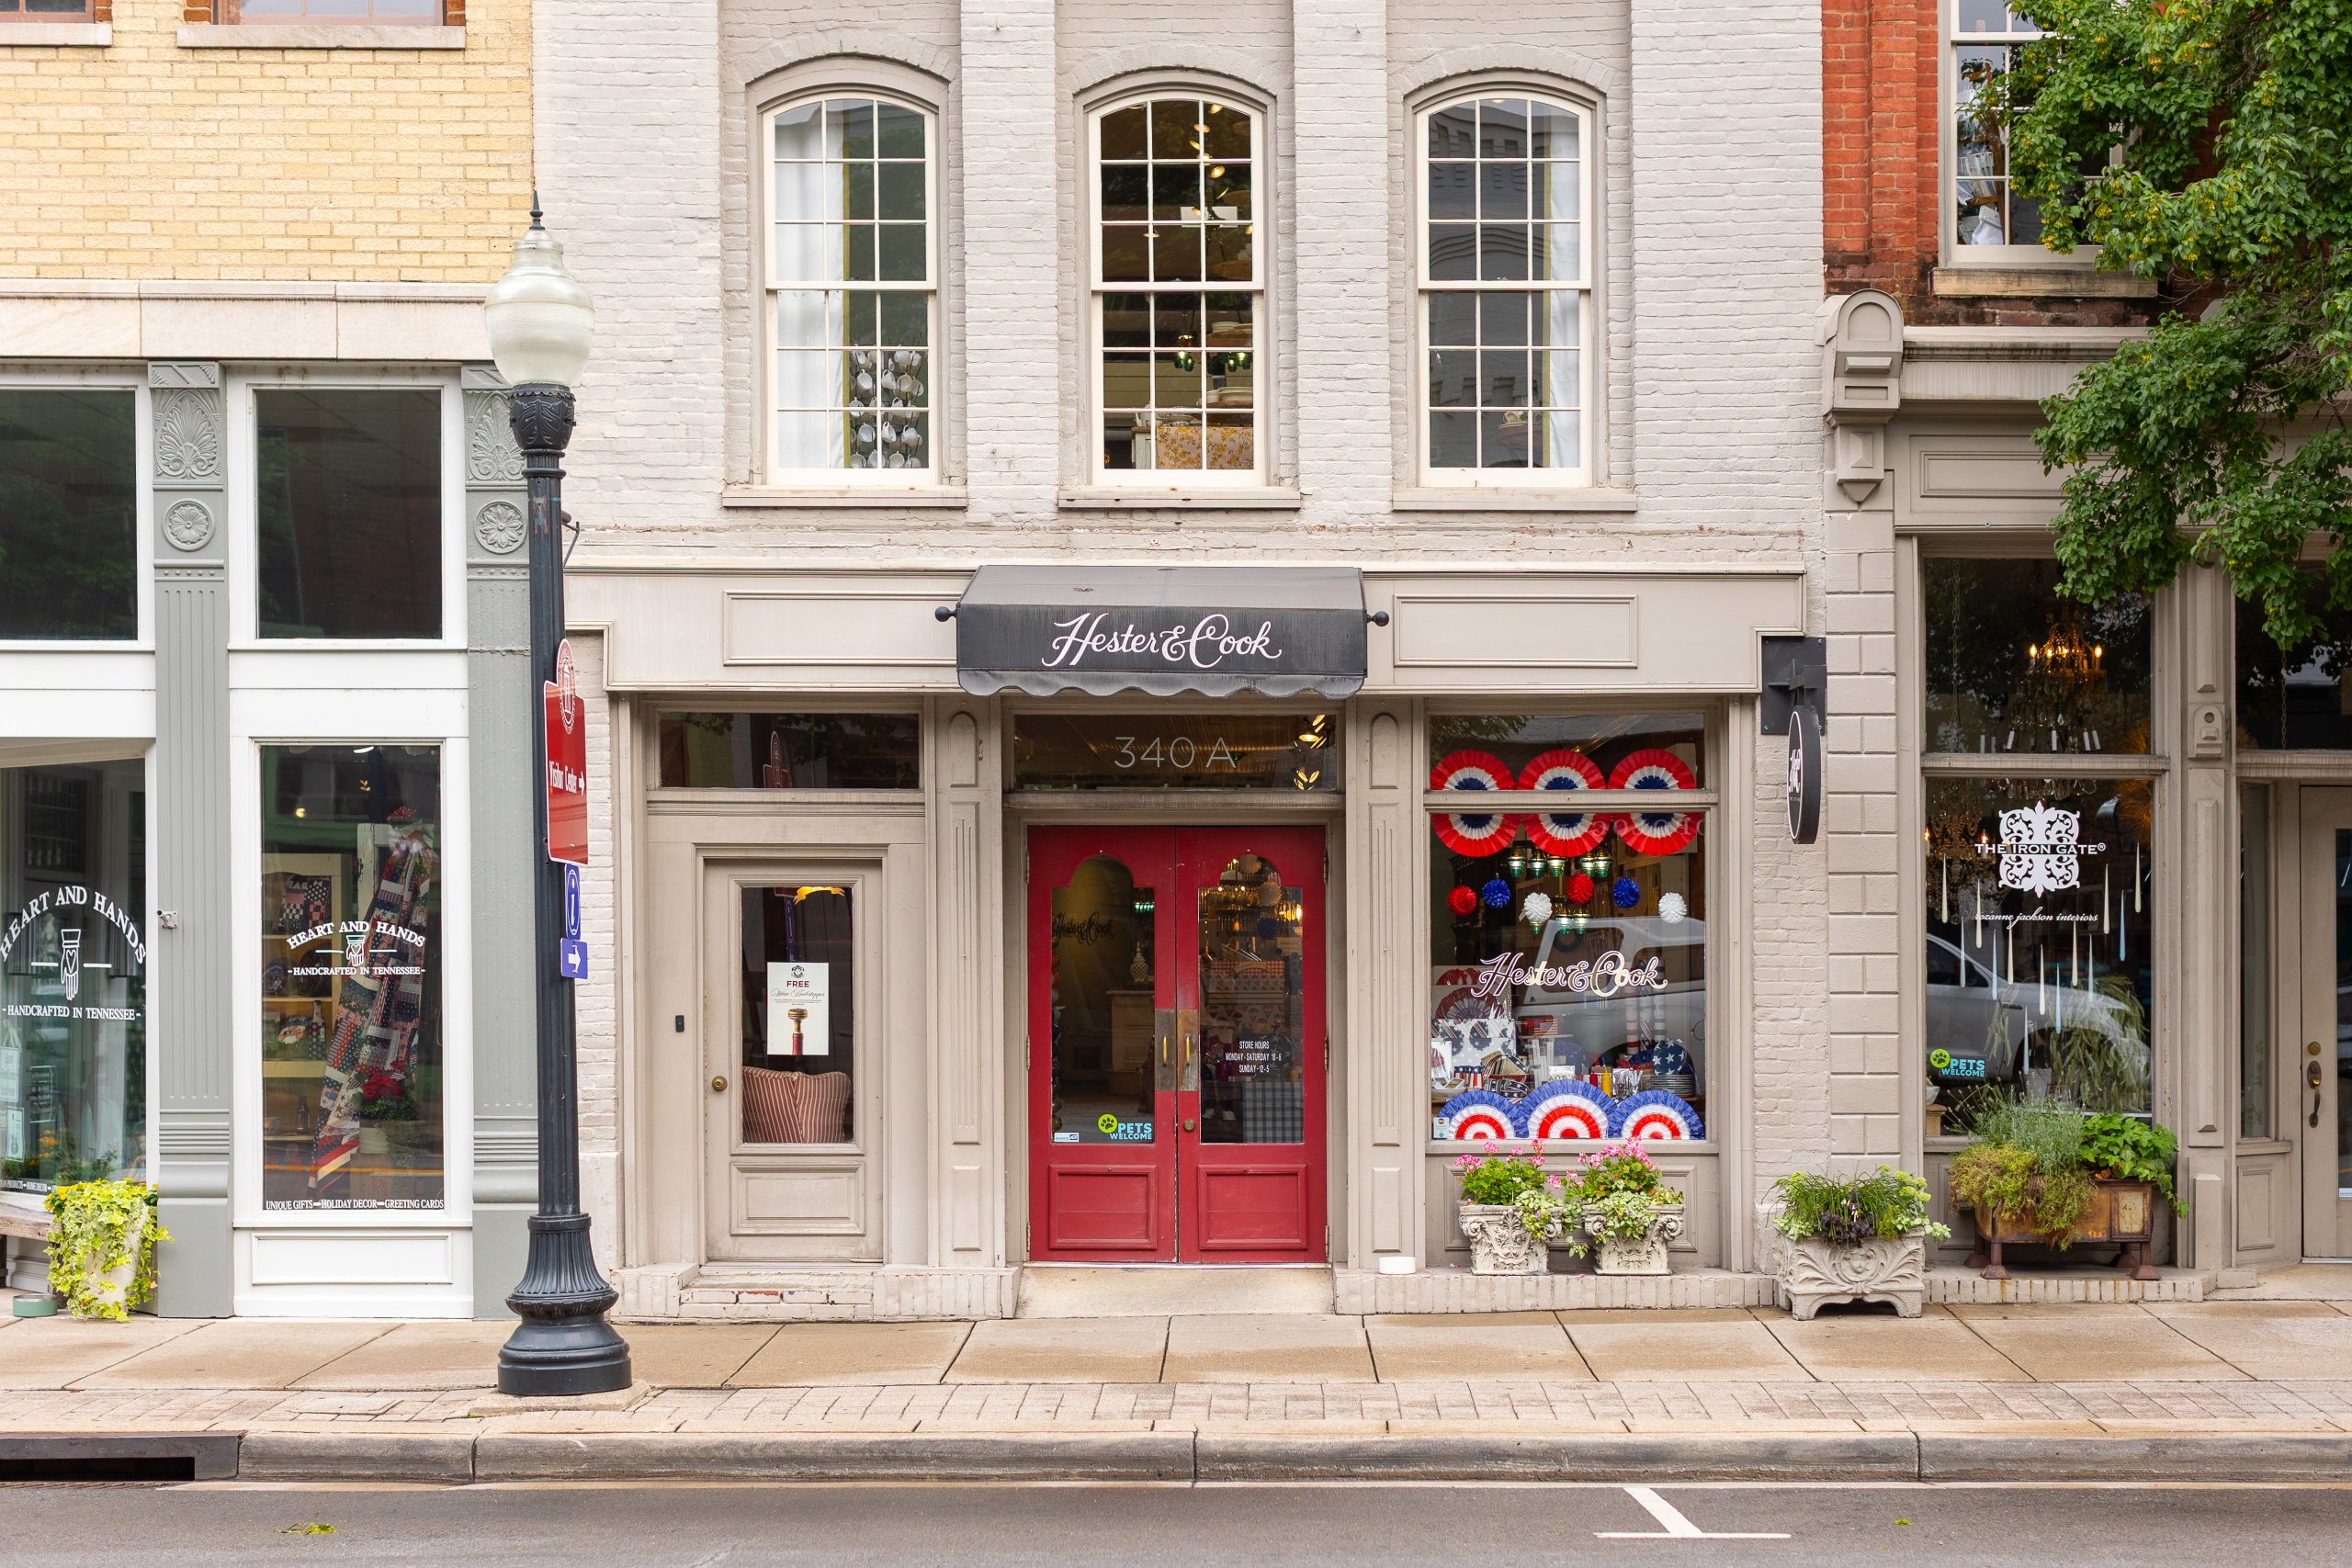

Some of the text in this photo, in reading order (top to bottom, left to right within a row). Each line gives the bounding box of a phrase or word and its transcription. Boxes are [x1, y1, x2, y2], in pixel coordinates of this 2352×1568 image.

[1114, 737, 1237, 768] 340 A
[548, 760, 577, 794] Visitor Center
[1974, 843, 2007, 854] THE
[2012, 843, 2053, 854] IRON
[2007, 906, 2053, 929] jackson
[2056, 912, 2098, 921] interiors
[0, 886, 146, 964] HEART AND HANDS
[287, 921, 425, 949] HEART AND HANDS
[73, 1007, 83, 1018] IN
[1239, 1041, 1270, 1049] STORE HOURS
[1950, 1058, 1984, 1070] PETS
[1941, 1068, 1984, 1077] WELCOME
[1117, 1122, 1152, 1134] PETS
[266, 1201, 292, 1210] UNIQUE
[421, 1199, 444, 1209] CARDS
